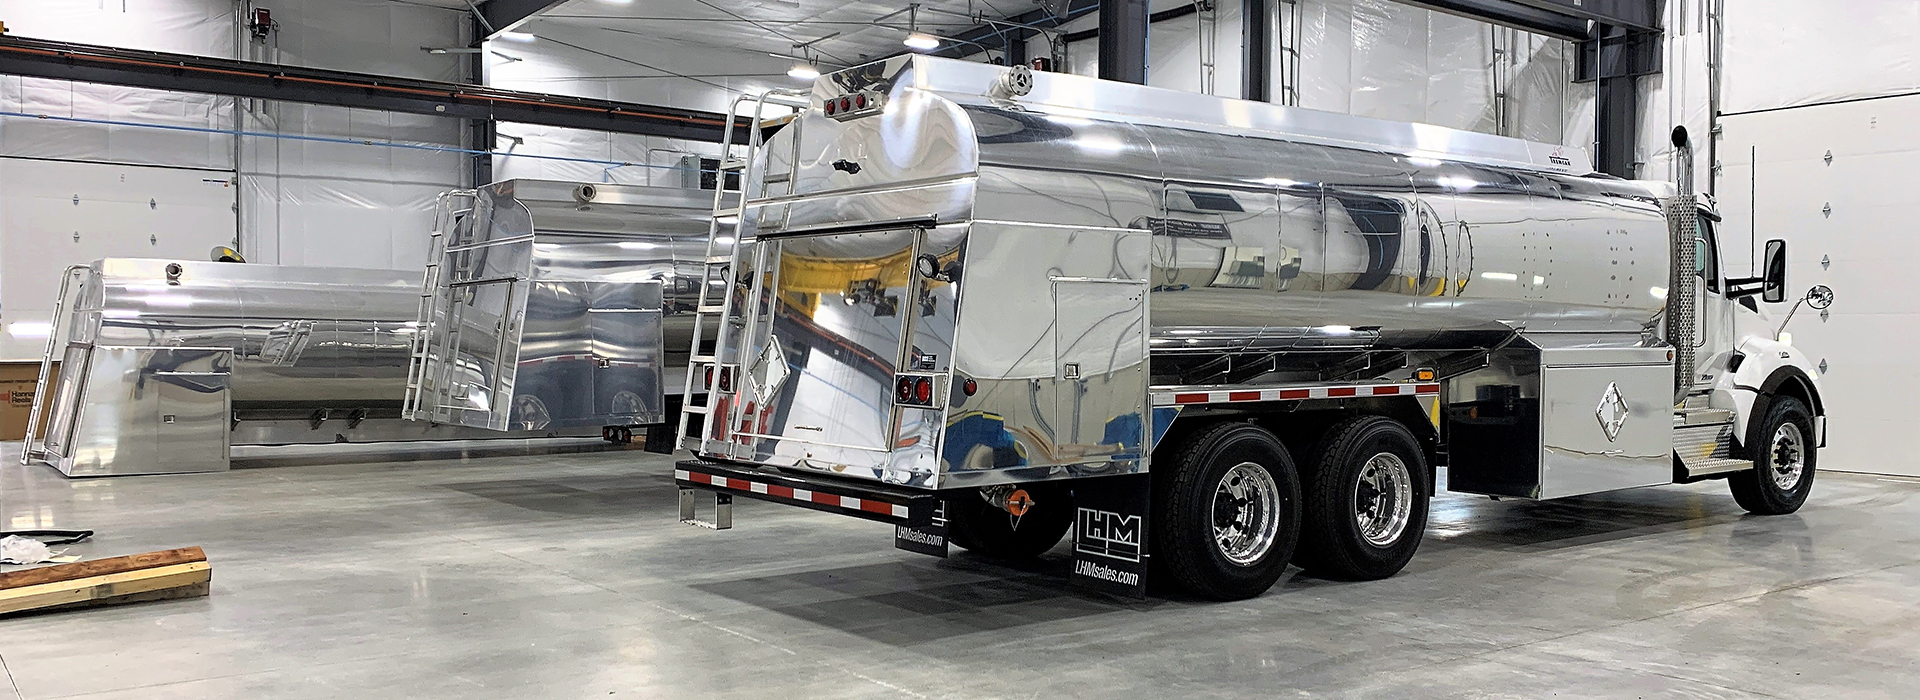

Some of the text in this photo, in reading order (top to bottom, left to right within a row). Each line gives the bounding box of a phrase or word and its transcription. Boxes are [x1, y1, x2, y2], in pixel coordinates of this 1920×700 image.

[897, 525, 943, 547] LHMsales.com
[1076, 507, 1141, 563] LHM
[1075, 559, 1139, 587] LHMsales.com
